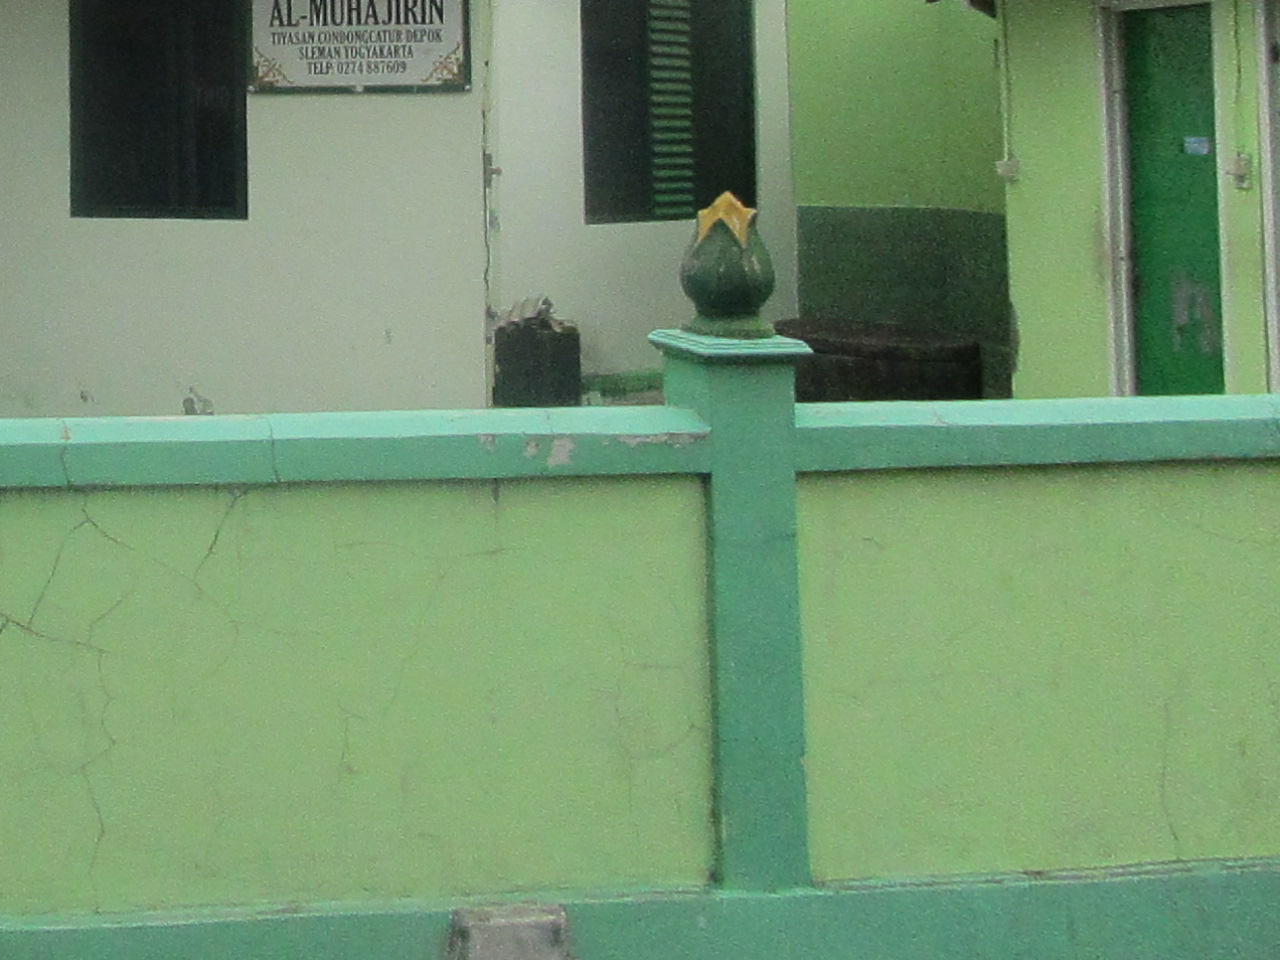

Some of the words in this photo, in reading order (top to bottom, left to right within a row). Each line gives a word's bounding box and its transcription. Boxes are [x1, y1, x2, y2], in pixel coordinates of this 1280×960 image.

[271, 31, 316, 46] TIYASAN
[317, 29, 404, 45] CONDONGCATUR
[406, 28, 444, 44] DEPOK
[298, 45, 341, 61] SLEMAN
[343, 44, 414, 60] YOGYAKARTA
[336, 60, 364, 75] 0274
[365, 60, 408, 75] 887609
